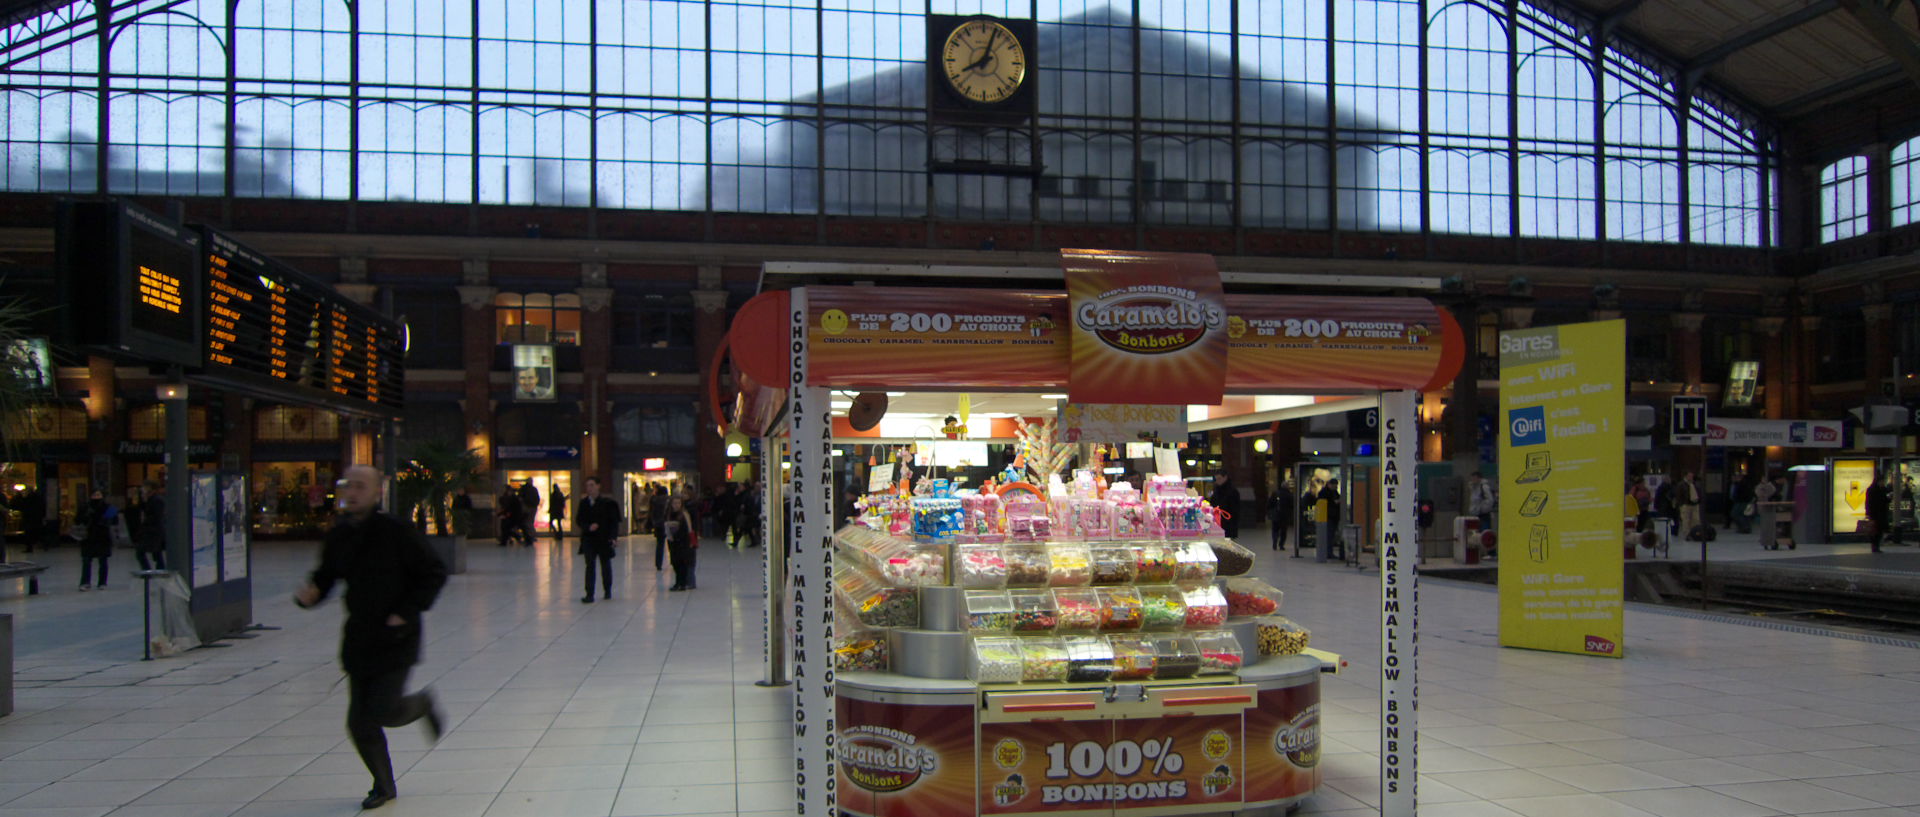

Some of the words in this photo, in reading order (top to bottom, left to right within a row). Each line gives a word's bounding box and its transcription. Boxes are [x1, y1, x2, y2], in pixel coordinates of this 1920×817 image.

[1098, 288, 1126, 299] 100%
[1128, 285, 1197, 299] BONBONS
[851, 313, 887, 322] PLUS
[889, 312, 952, 333] 200
[954, 314, 1026, 323] PRODUITS
[1079, 302, 1220, 326] Caramelo's
[1249, 319, 1282, 328] PLUS
[859, 322, 880, 331] DE
[960, 323, 977, 332] AU
[979, 323, 1022, 332] CHOIX
[1257, 328, 1275, 336] DE
[1284, 318, 1340, 338] 200
[1341, 321, 1404, 330] PRODUITS
[1345, 330, 1363, 338] AU
[1363, 330, 1402, 339] CHOIX
[1118, 332, 1185, 348] Bonbons
[1499, 334, 1553, 354] Gares
[792, 310, 803, 429] CHOCOLAT
[1366, 409, 1377, 428] 6
[1733, 429, 1784, 440] partenaires
[1815, 430, 1836, 439] SNCF
[822, 412, 832, 514] CARAMEL
[1384, 418, 1399, 513] CARAMEL
[793, 450, 805, 553] CARAMEL
[1384, 532, 1399, 681] MARSHMALLOW
[822, 536, 835, 698] MARSHMALLOW
[793, 574, 807, 737] MARSHMALLOW
[1586, 640, 1615, 651] SNCF
[860, 725, 916, 745] BONBONS
[1046, 736, 1184, 777] 100%
[1386, 700, 1399, 793] BONBONS
[852, 767, 902, 787] Bonbons
[1041, 780, 1187, 803] BONBONS
